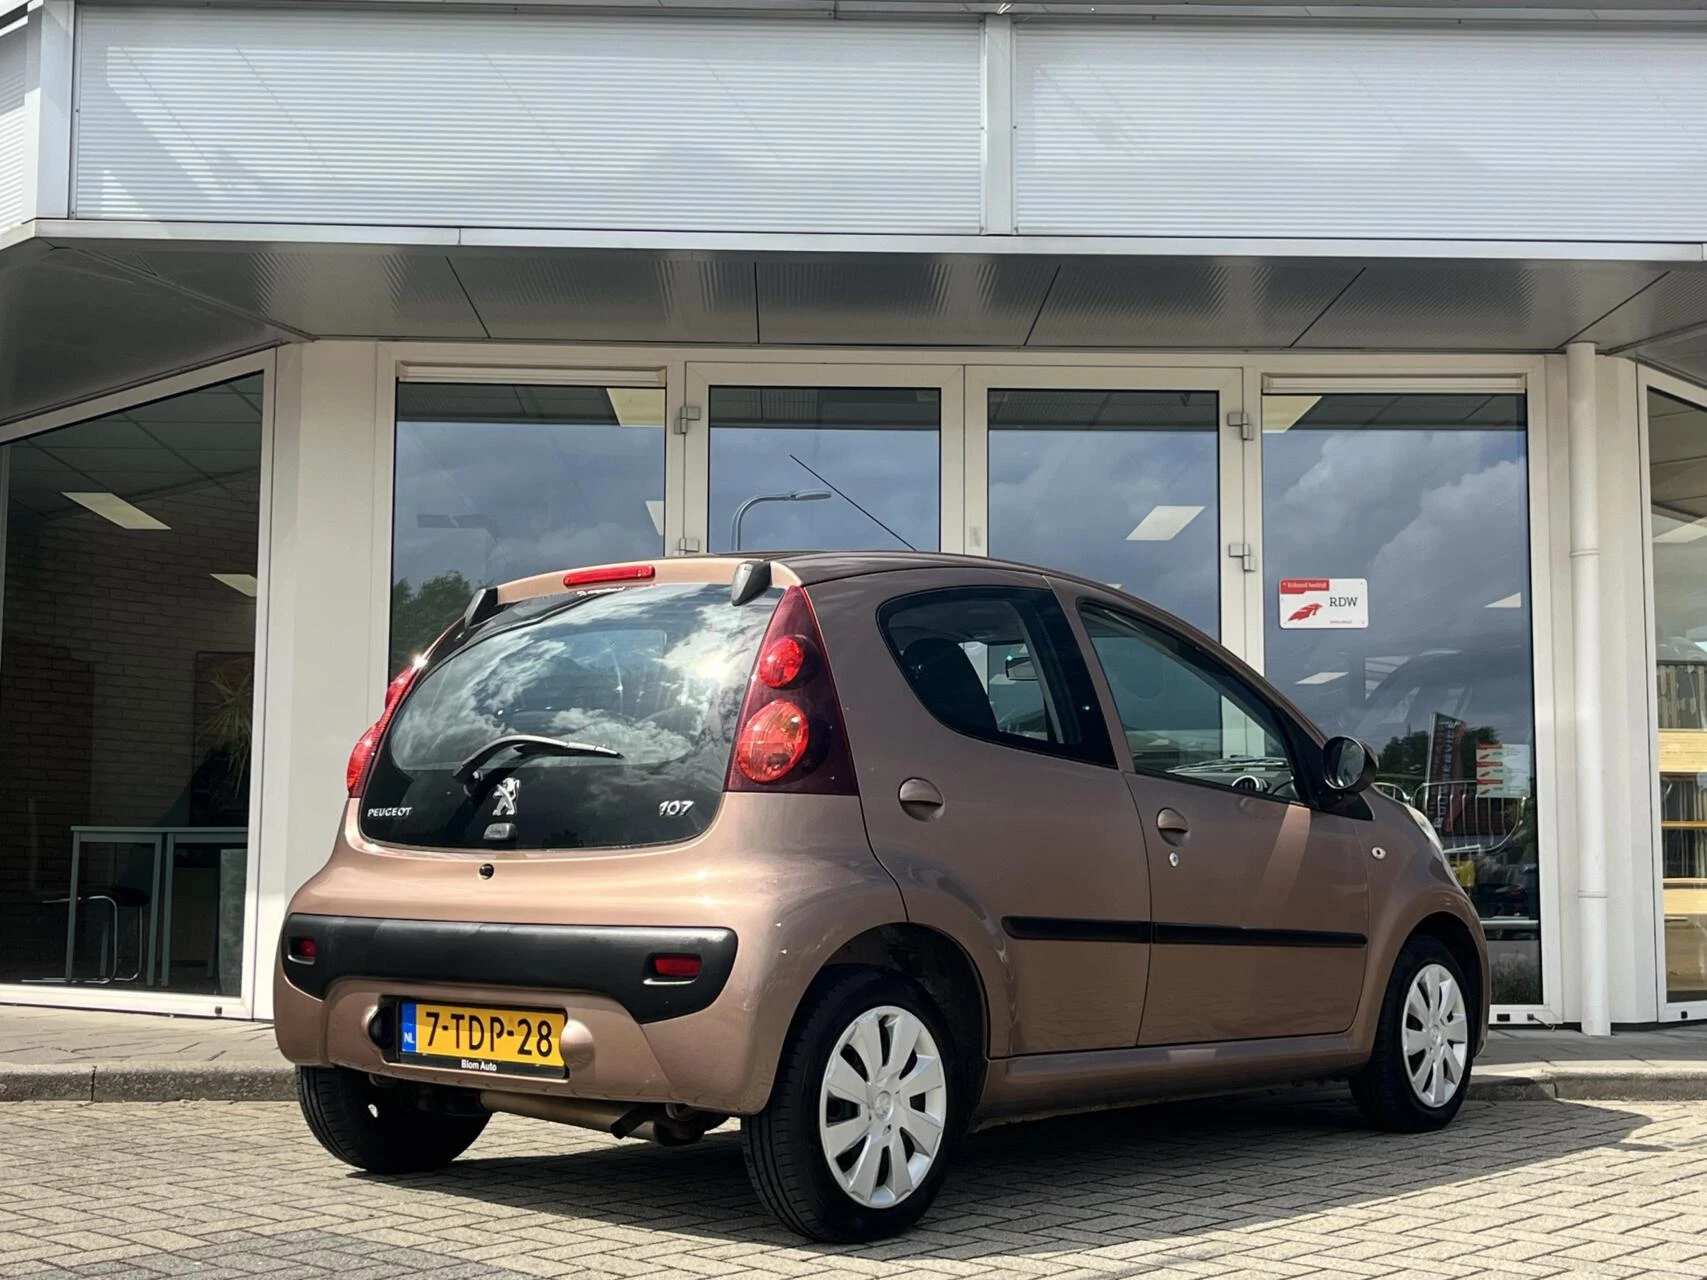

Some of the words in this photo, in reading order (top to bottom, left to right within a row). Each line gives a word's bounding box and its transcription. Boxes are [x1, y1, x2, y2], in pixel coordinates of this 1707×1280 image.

[1329, 597, 1358, 607] RDW
[367, 807, 412, 817] PEUGEOT
[659, 800, 694, 816] 107
[404, 1032, 415, 1044] NL
[425, 1011, 552, 1058] 7-TDP-28
[461, 1059, 479, 1070] Blom
[480, 1061, 497, 1072] Auto
